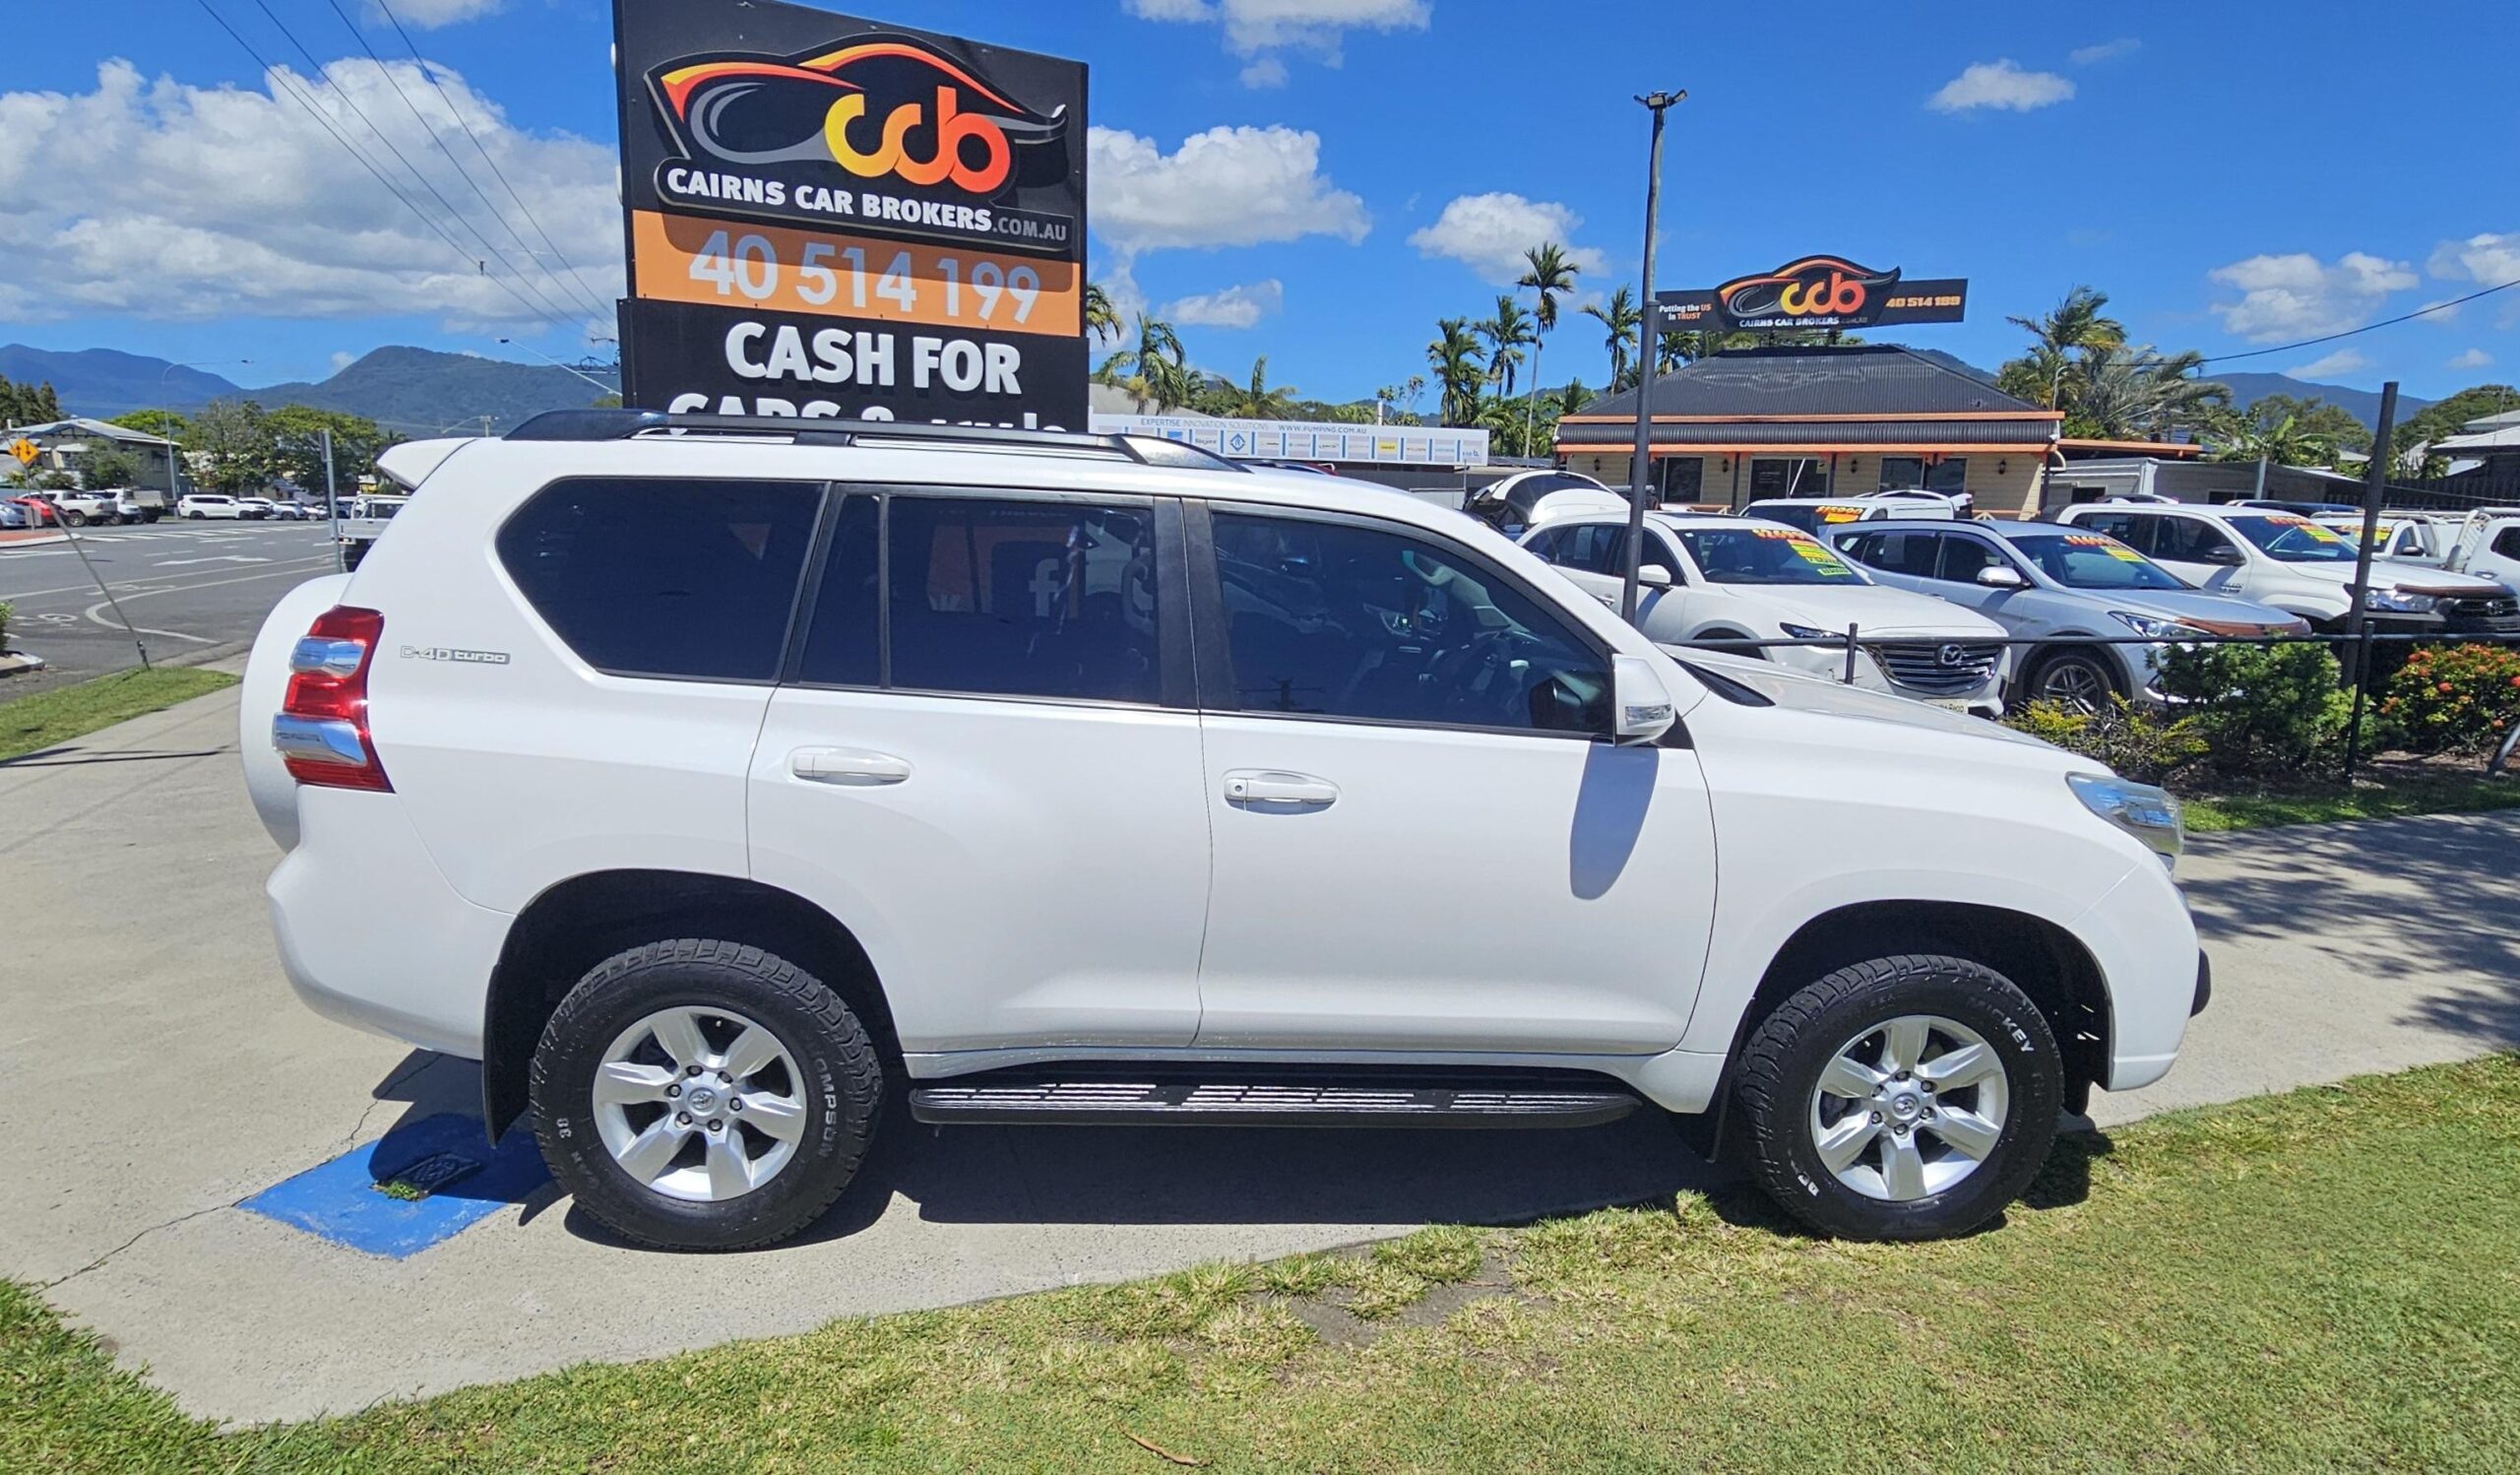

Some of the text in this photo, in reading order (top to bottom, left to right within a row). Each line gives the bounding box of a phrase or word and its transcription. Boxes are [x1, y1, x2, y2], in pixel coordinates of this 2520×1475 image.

[666, 167, 787, 206] CAIRNS
[794, 185, 853, 216] CAR
[689, 229, 1040, 325] 40 514 199
[1775, 318, 1794, 327] CAR
[724, 321, 1022, 395] CASH FOR
[453, 650, 507, 664] turbo
